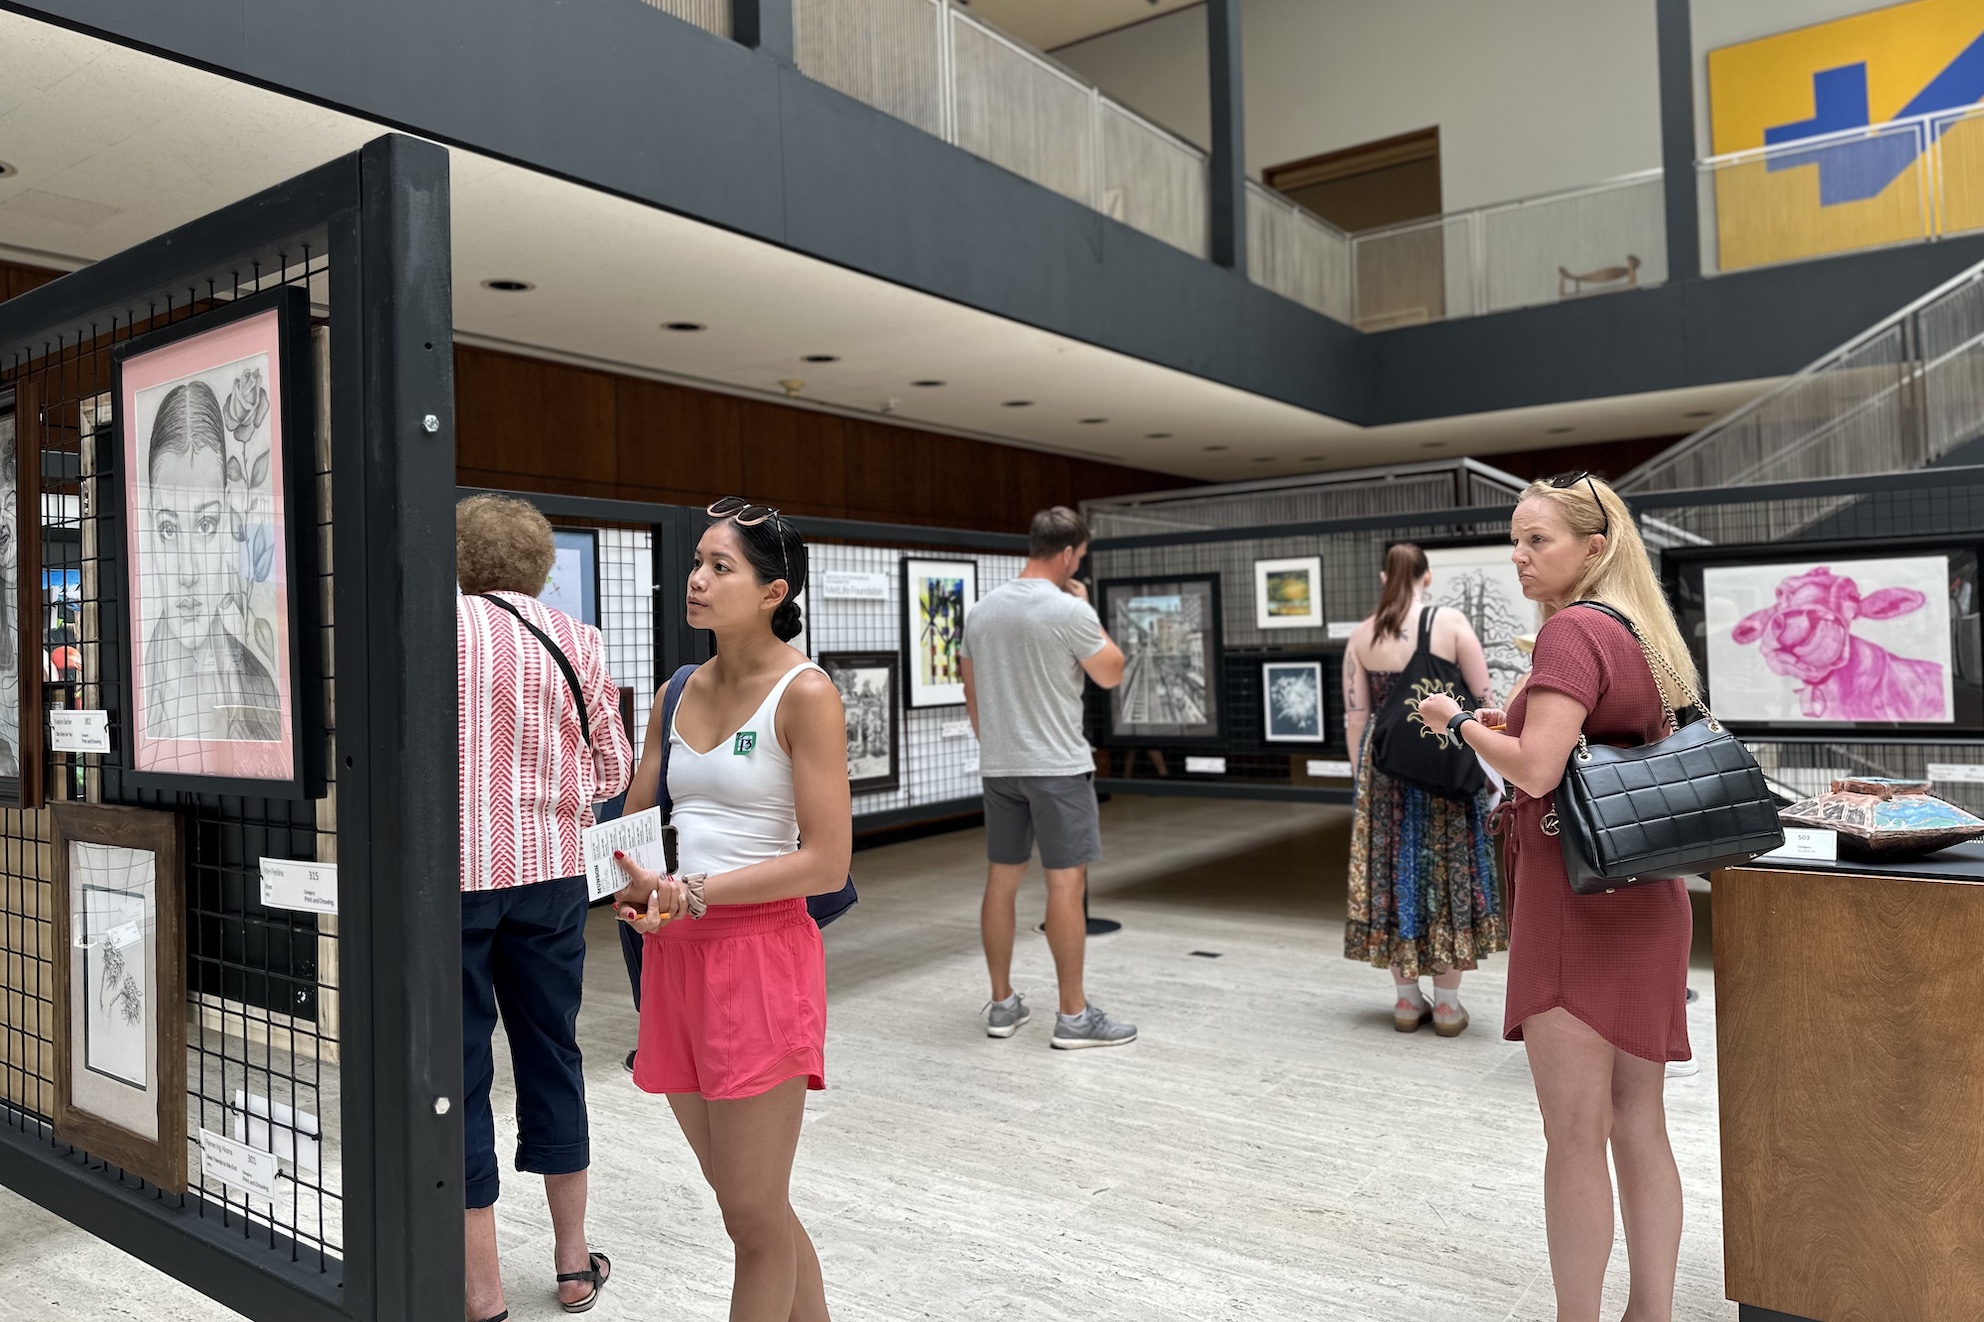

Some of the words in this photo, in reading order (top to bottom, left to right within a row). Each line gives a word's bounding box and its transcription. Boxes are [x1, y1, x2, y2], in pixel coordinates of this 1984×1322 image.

[309, 871, 319, 880] 315
[320, 897, 334, 907] Drawing
[247, 1154, 256, 1165] 301
